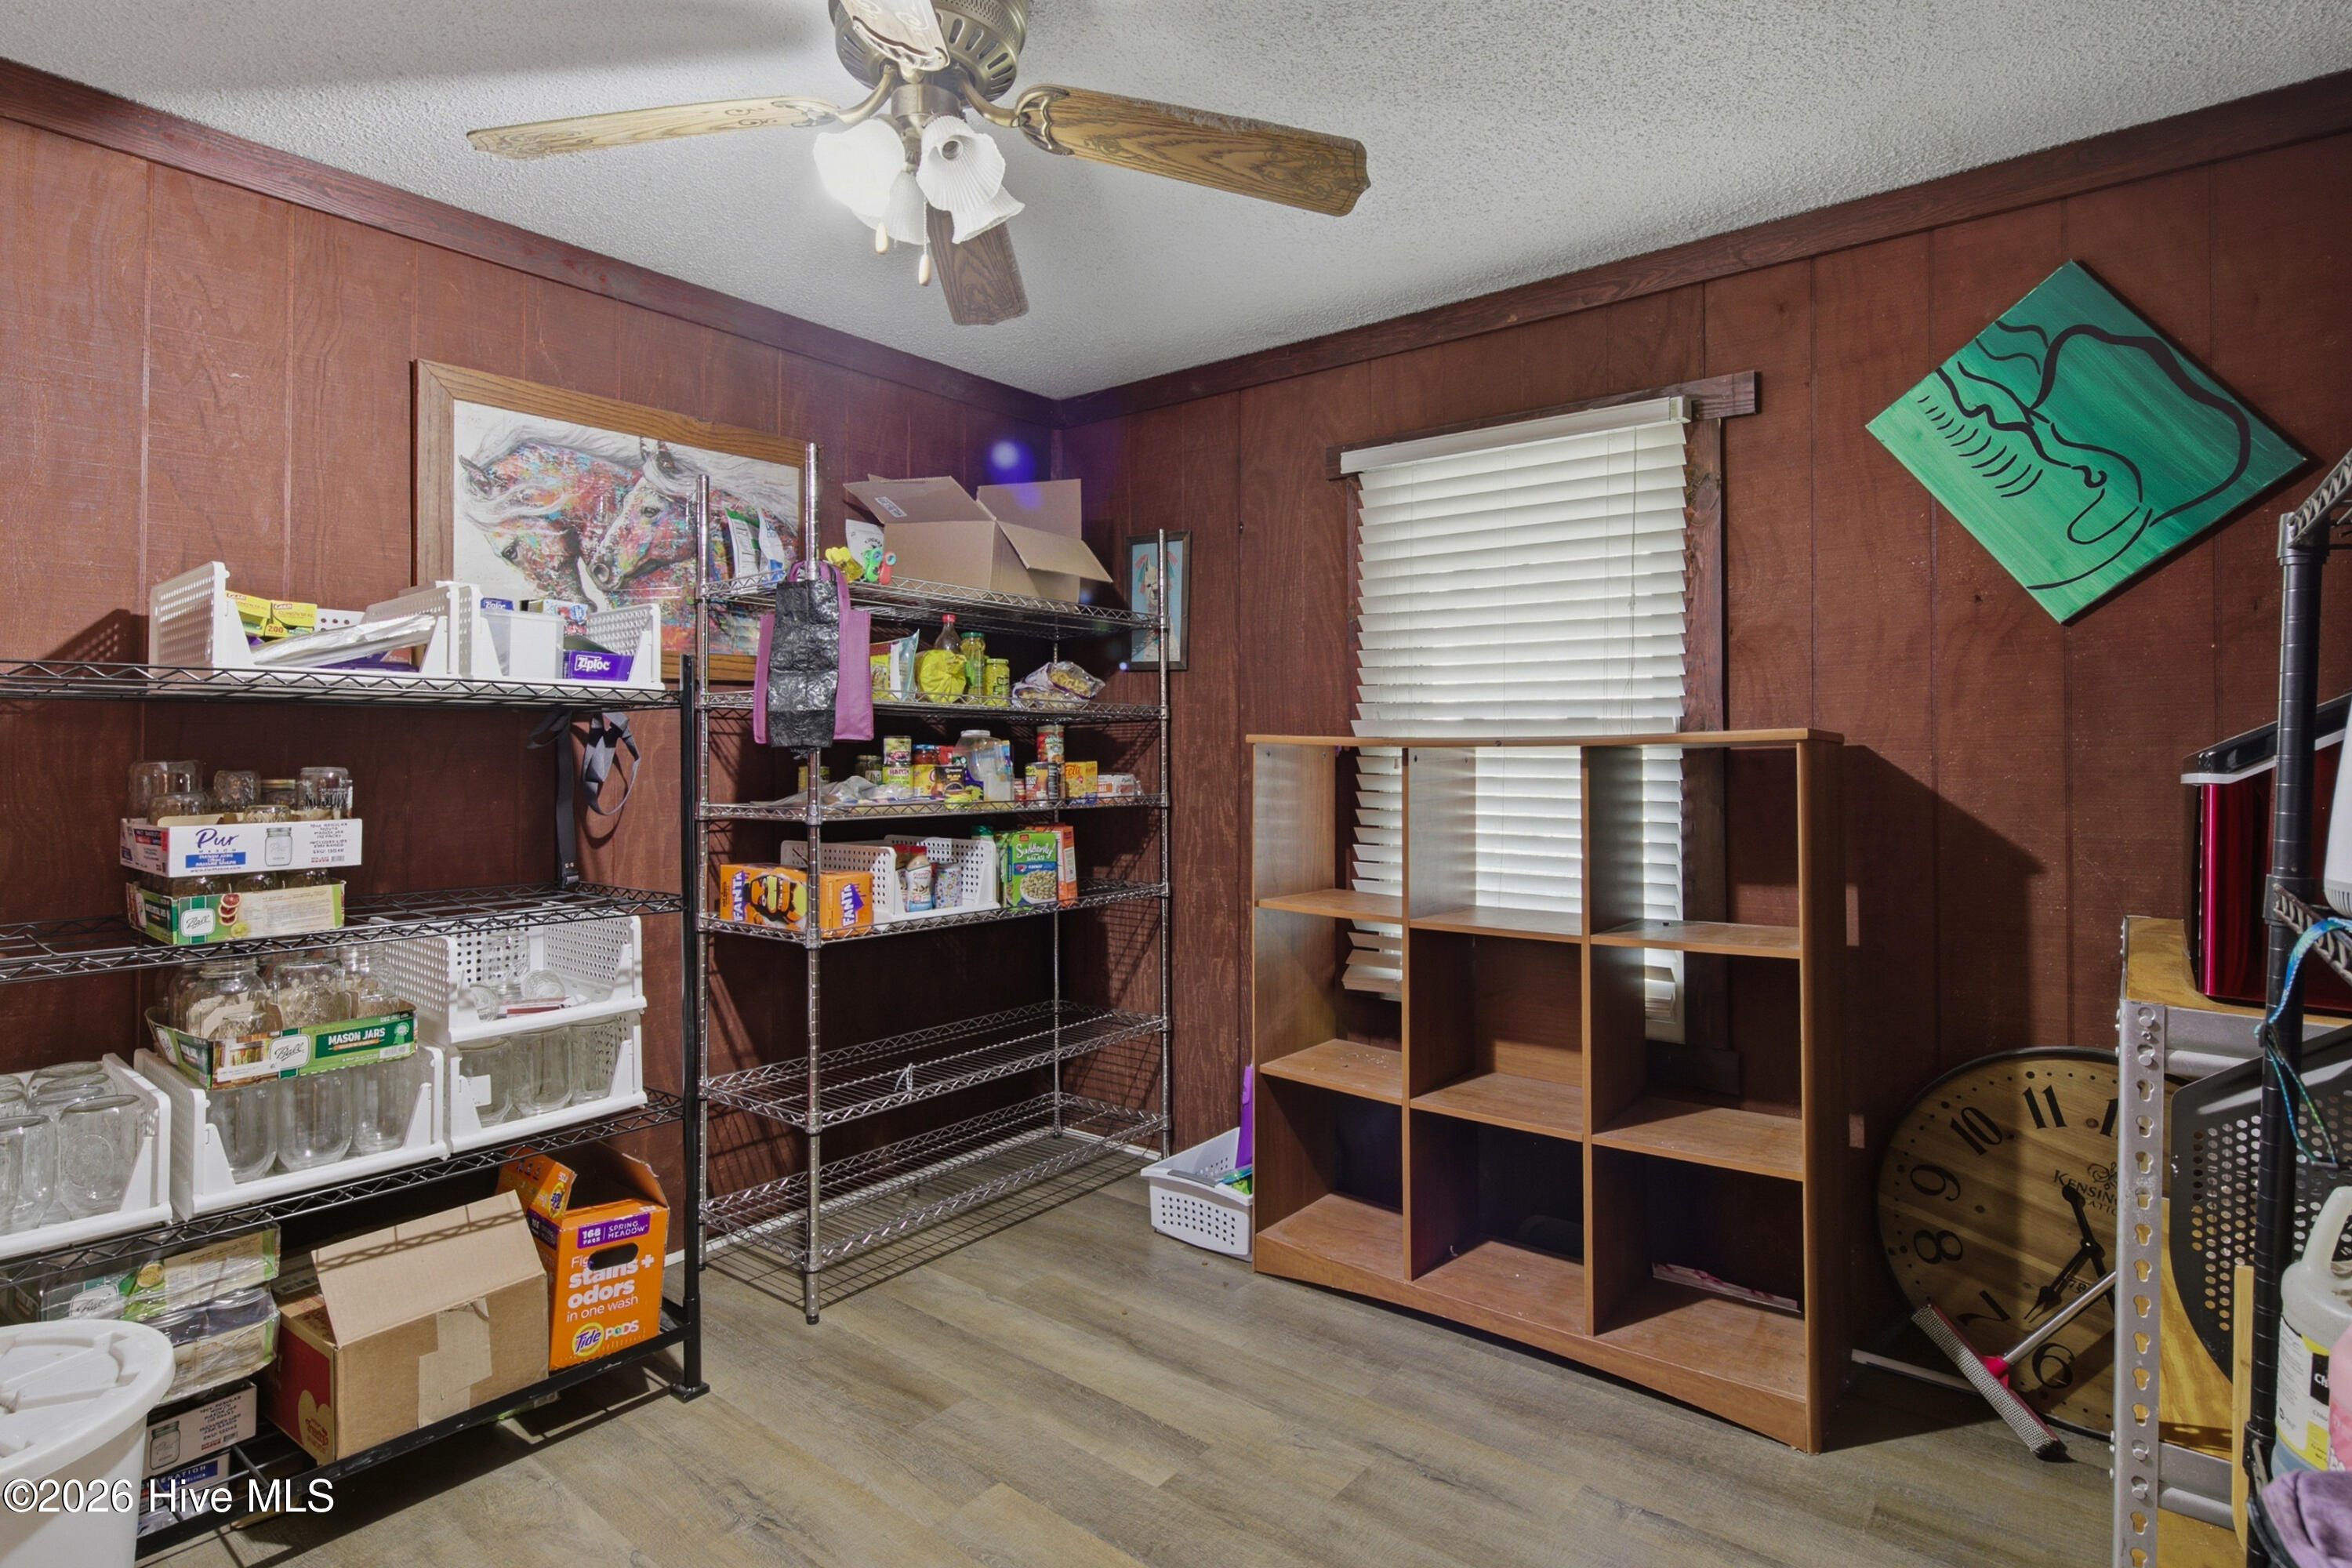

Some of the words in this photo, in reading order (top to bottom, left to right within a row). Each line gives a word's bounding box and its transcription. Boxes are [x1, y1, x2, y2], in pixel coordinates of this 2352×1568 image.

[267, 625, 284, 633] 200
[577, 655, 612, 672] Ziploc
[195, 828, 239, 849] Pur
[731, 871, 743, 923] FANTA
[841, 884, 856, 927] FANTA
[328, 1030, 361, 1046] MASON
[362, 1027, 386, 1041] JARS
[274, 1042, 305, 1062] Ball
[2023, 1085, 2067, 1129] 11
[2100, 1098, 2118, 1138] 1
[1951, 1107, 2002, 1156] 10
[1910, 1164, 1961, 1202] 9
[2053, 1169, 2118, 1205] KENSIN
[582, 1228, 601, 1240] 168
[608, 1221, 639, 1233] SPRING
[608, 1225, 645, 1240] MEADOW
[1914, 1229, 1963, 1265] 8
[568, 1258, 639, 1289] stains
[571, 1254, 590, 1269] Fig
[567, 1279, 636, 1308] odors
[566, 1311, 578, 1323] in
[581, 1305, 605, 1319] one
[607, 1295, 639, 1312] wash
[1957, 1290, 2011, 1327] 7
[575, 1329, 601, 1354] Tide
[604, 1319, 640, 1341] PODS
[2031, 1342, 2076, 1389] 6
